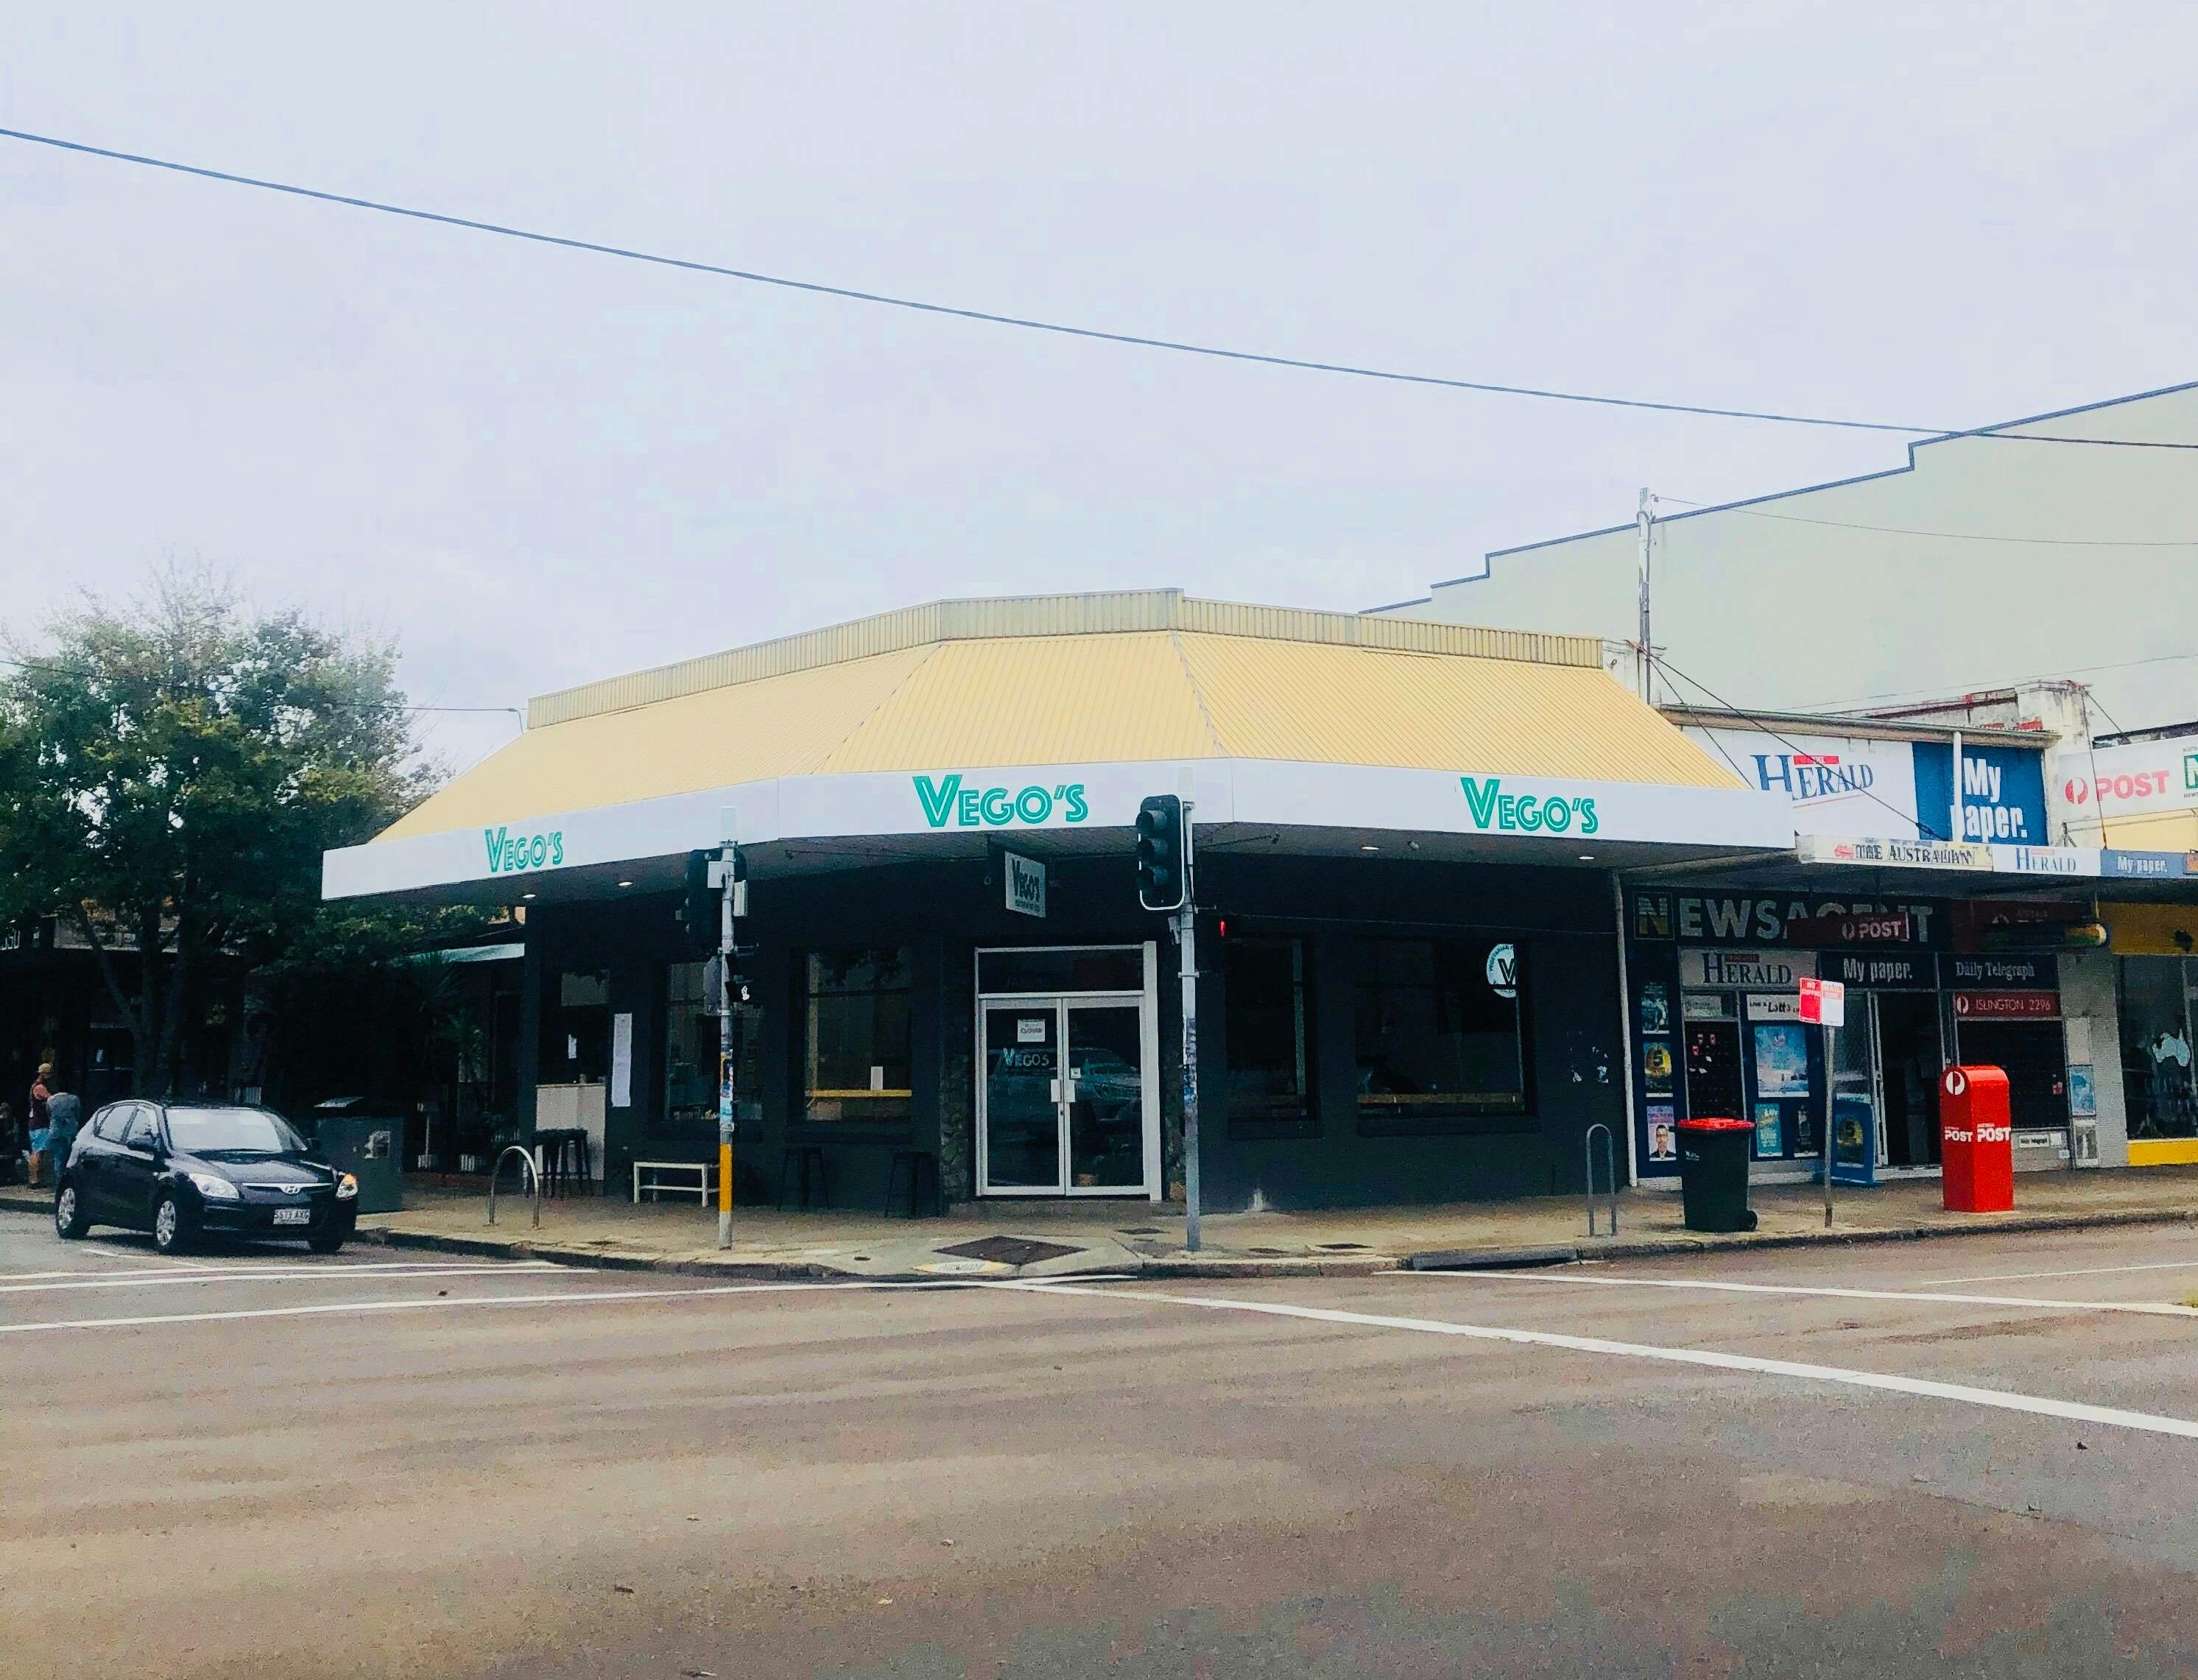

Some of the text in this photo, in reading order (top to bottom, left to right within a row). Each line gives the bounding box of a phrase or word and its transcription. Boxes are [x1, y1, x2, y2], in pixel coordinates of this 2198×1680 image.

[1750, 755, 1873, 801] HERALD
[1963, 758, 2001, 803] My
[2095, 770, 2169, 802] POST
[912, 774, 1088, 827] VEGO'S
[1460, 777, 1599, 834] VEGO'S
[485, 827, 563, 872] VEGO'S
[2015, 847, 2077, 872] HERALD
[2117, 855, 2134, 874] My
[2136, 858, 2169, 874] paper.
[1638, 896, 1934, 943] NEWSAT
[1859, 920, 1902, 938] POST
[1702, 953, 1792, 985] HERALD
[1844, 958, 1913, 983] My paper.
[1956, 961, 2035, 981] Daily Telegraph
[1976, 998, 2051, 1011] ISLINGTON 2296
[1944, 1129, 1973, 1143] POST
[1976, 1126, 2012, 1143] POST
